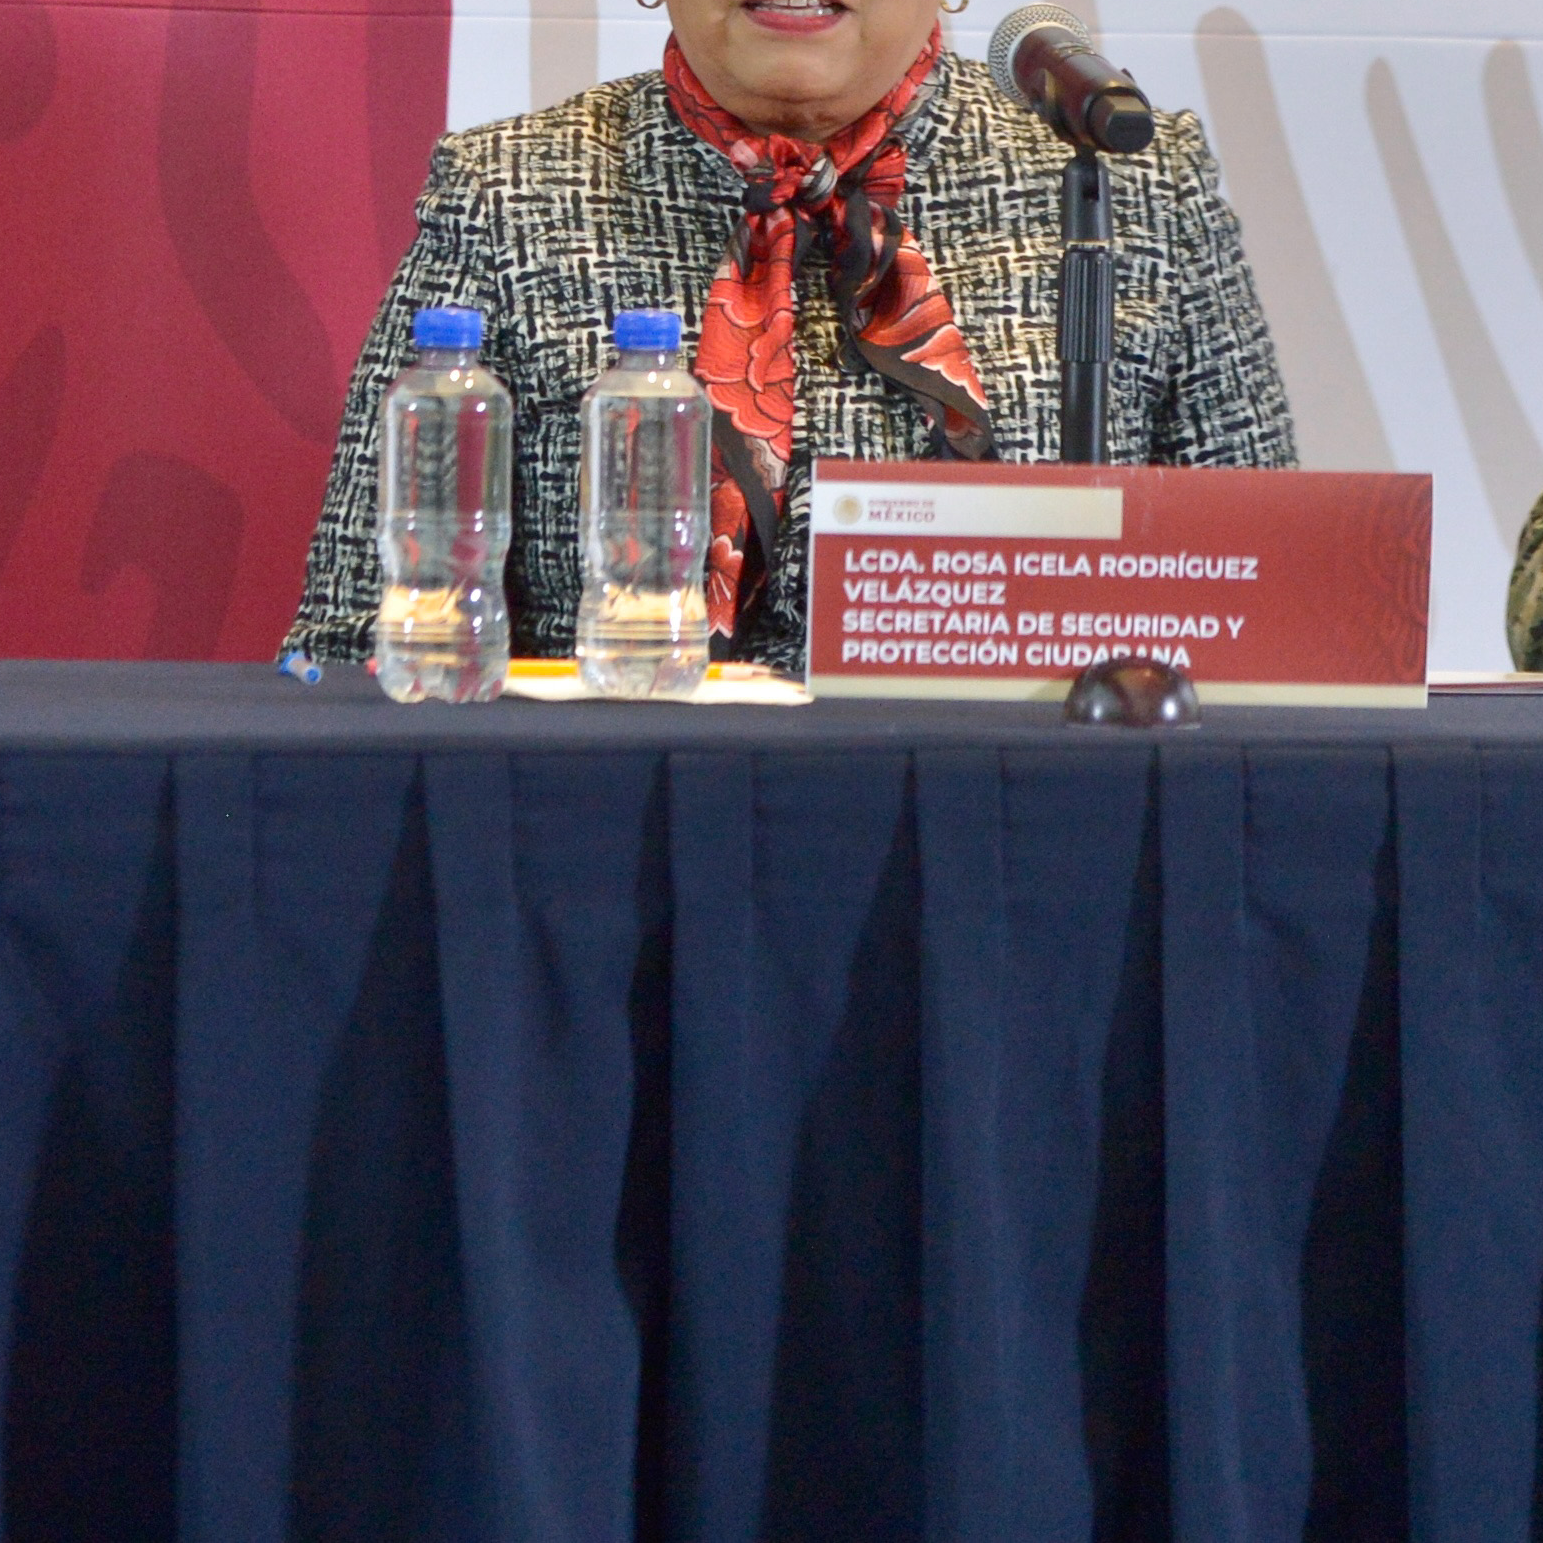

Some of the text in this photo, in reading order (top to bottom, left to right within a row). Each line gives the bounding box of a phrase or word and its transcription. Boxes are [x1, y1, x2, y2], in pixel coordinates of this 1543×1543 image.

[844, 549, 1258, 580] LCDA. ROSA ICELA RODRÍGUEZ
[843, 576, 1006, 607] VELÁZQUEZ
[842, 608, 1245, 639] SECRETARIA DE SEGURIDAD Y
[842, 637, 1018, 666] PROTECCIÓN
